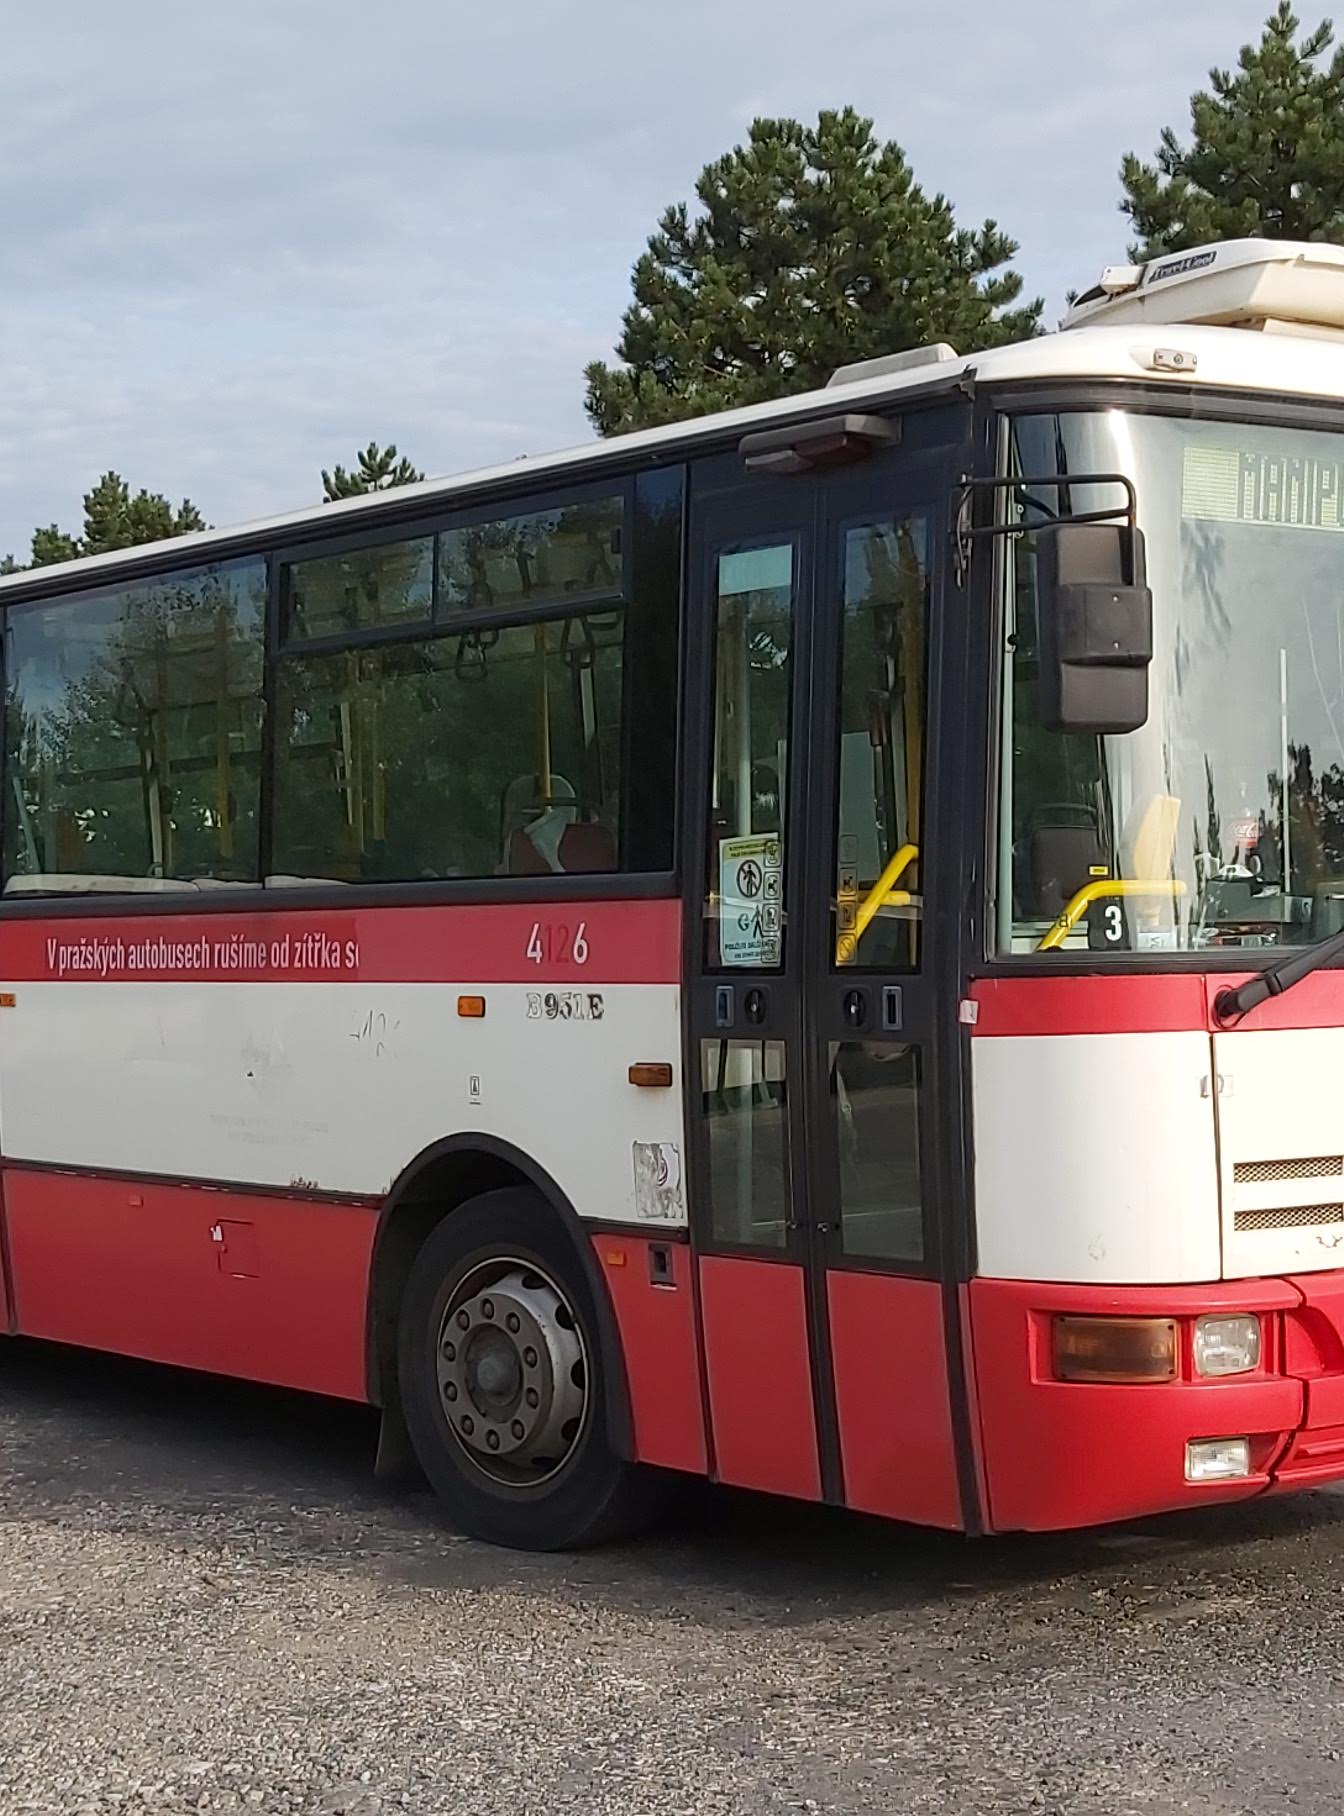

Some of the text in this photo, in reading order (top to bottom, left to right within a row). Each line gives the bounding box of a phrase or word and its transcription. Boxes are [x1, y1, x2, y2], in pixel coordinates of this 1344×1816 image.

[526, 922, 589, 965] 4126
[1105, 905, 1122, 942] 3
[47, 937, 57, 970] V
[59, 936, 125, 977] pražských
[128, 935, 210, 969] autobusech
[214, 934, 267, 969] rušíme
[271, 933, 290, 969] od
[293, 932, 341, 969] zítřka
[526, 991, 605, 1020] B951E
